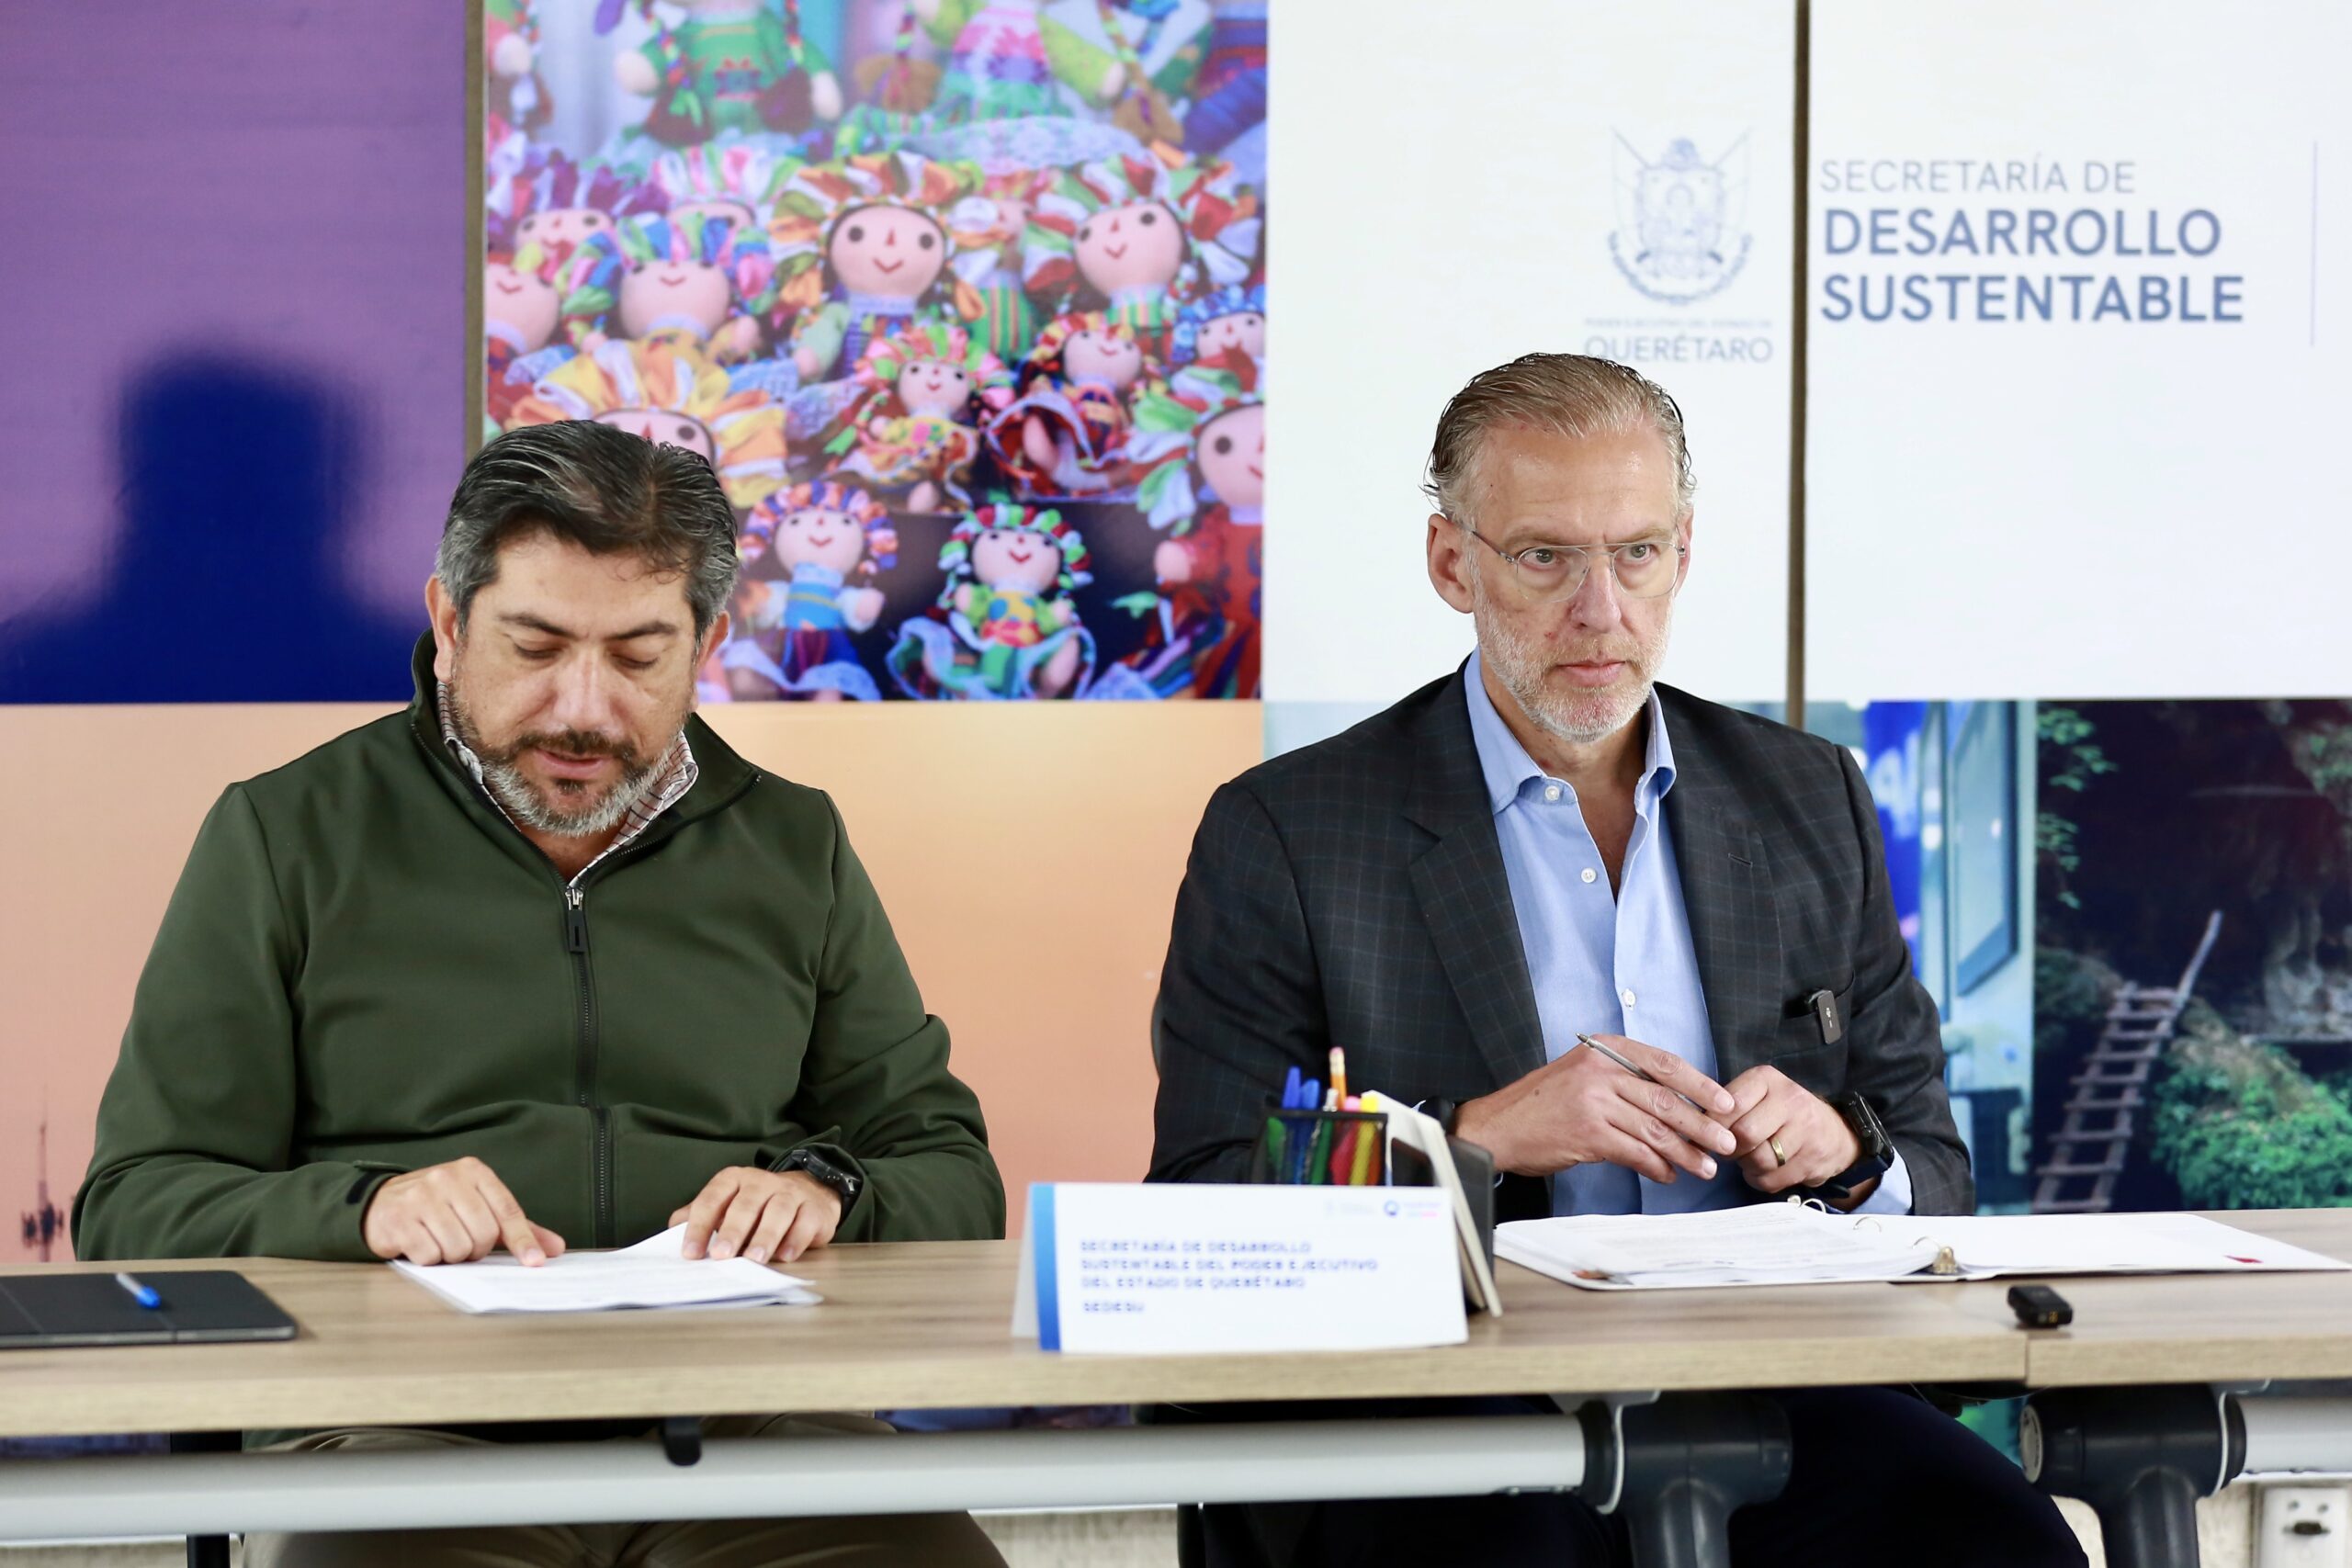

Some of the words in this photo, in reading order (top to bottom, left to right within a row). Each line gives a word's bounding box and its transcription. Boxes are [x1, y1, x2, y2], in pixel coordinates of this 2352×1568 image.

[1820, 152, 2068, 194] SECRETARÍA
[2084, 162, 2135, 194] DE
[1825, 209, 2222, 257] DESARROLLO
[1821, 274, 2245, 321] SUSTENTABLE
[1585, 333, 1773, 363] QUERÉTARO
[1182, 1240, 1202, 1252] DE
[1208, 1240, 1311, 1253] DESARROLLO
[1081, 1258, 1191, 1270] SUSTENTABLE
[1197, 1258, 1226, 1271] DEL
[1232, 1258, 1283, 1271] PODER
[1289, 1258, 1378, 1271] EJECUTIVO
[1081, 1276, 1110, 1289] DEL
[1118, 1276, 1179, 1289] ESTADO
[1185, 1276, 1204, 1289] DE
